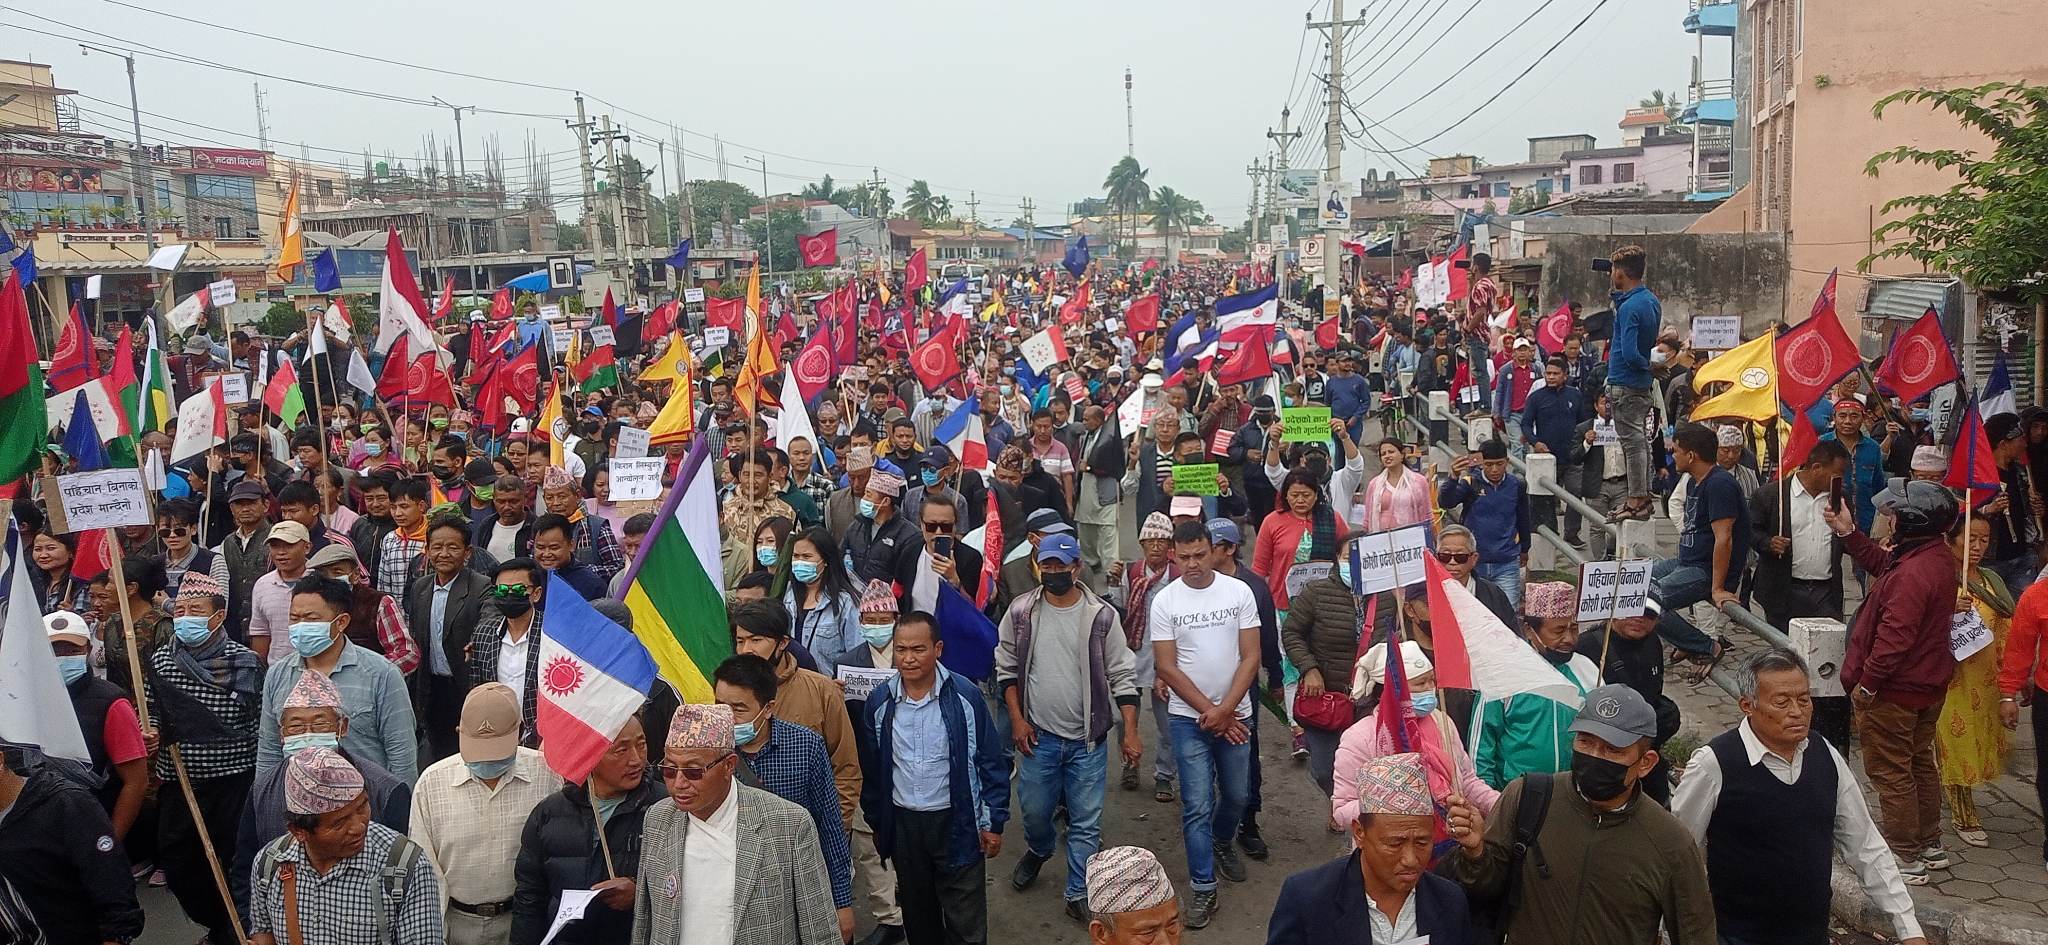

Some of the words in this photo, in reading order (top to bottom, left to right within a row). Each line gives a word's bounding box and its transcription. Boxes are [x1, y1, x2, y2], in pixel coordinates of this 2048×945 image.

[64, 484, 102, 497] पहिचान
[70, 503, 93, 517] प्रदेश
[1589, 568, 1617, 588] पहिचान
[1580, 594, 1600, 612] कोशी
[1172, 612, 1198, 626] RICH
[1202, 614, 1209, 622] &
[1210, 607, 1240, 620] KING
